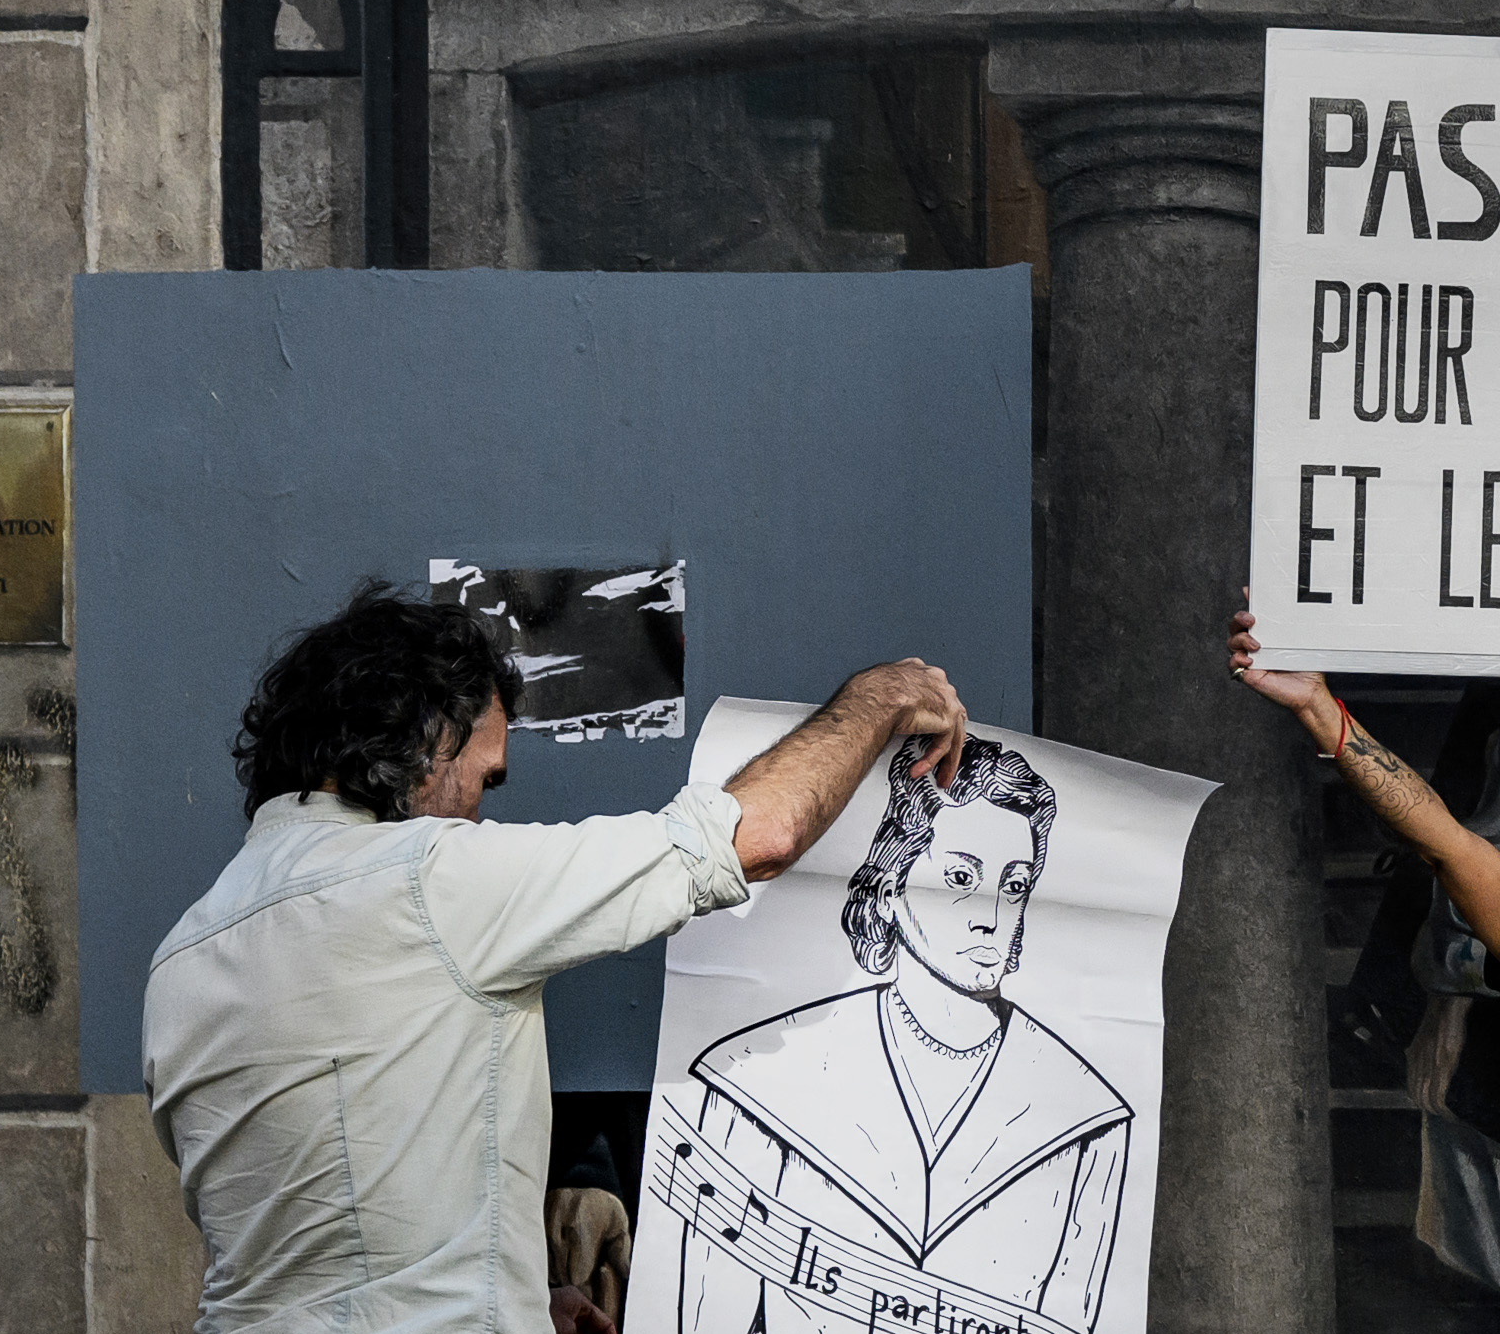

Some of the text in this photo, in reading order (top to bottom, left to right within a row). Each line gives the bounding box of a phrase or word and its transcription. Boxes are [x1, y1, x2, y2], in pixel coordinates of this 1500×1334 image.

[1310, 280, 1473, 424] POUR
[1298, 465, 1380, 604] ET
[789, 1227, 841, 1295] Ils
